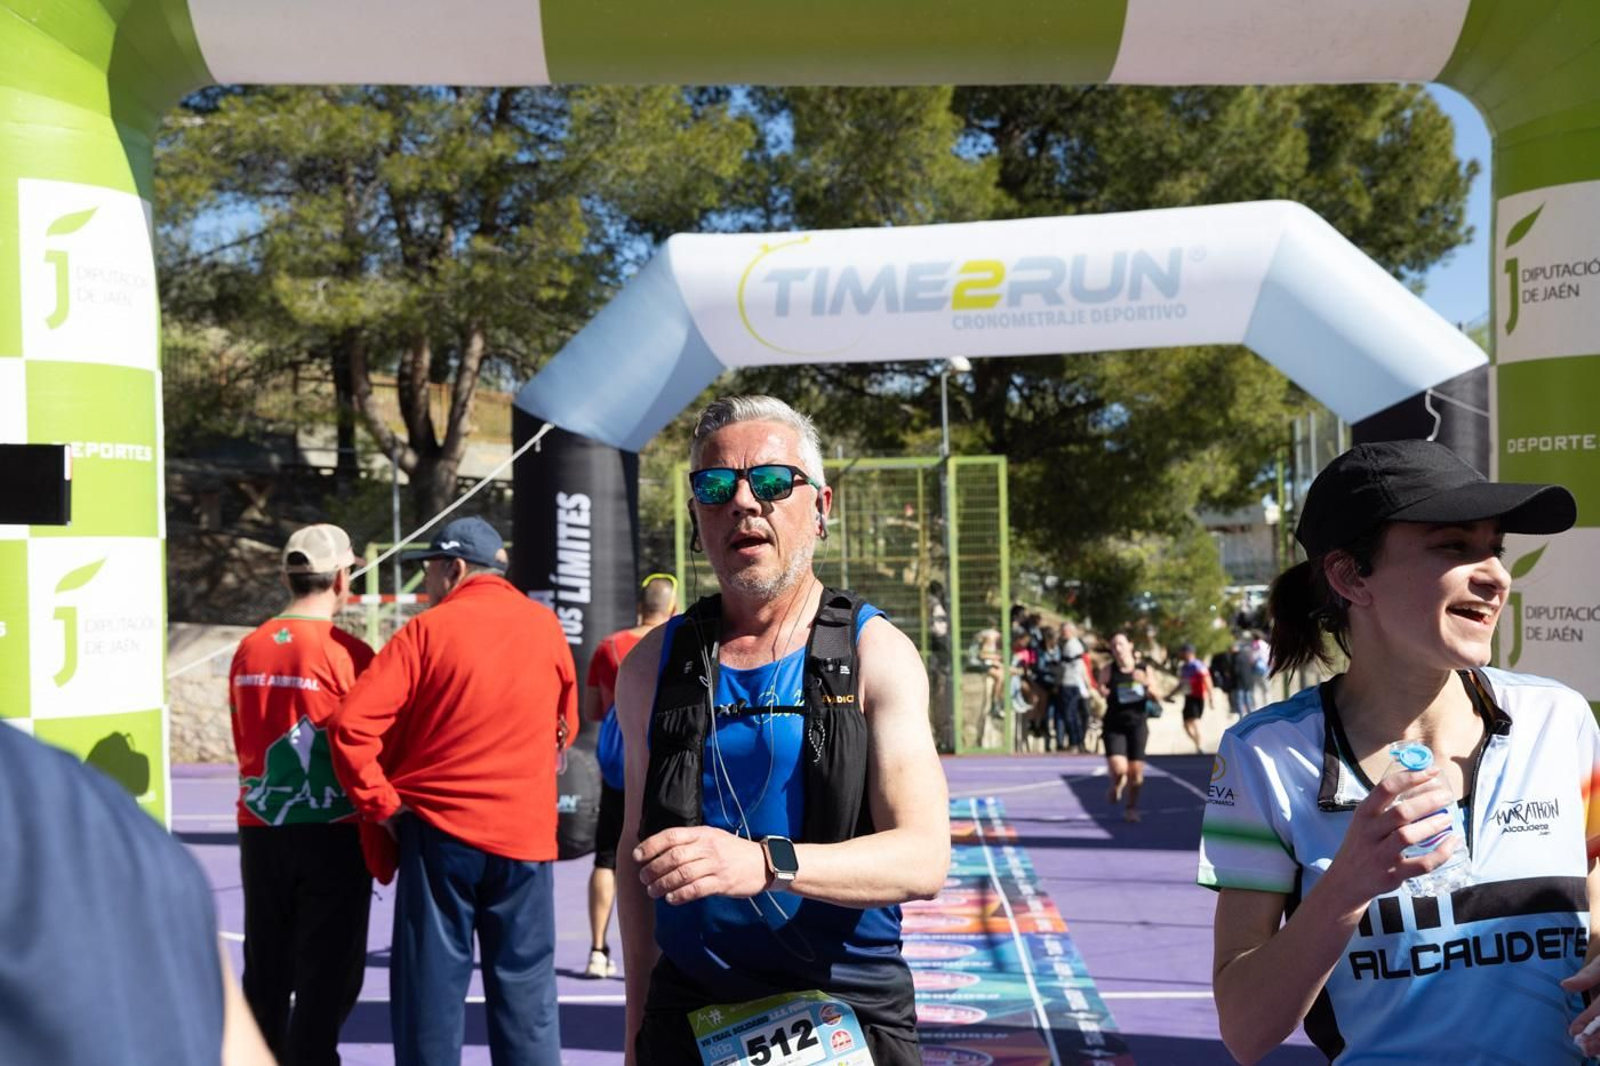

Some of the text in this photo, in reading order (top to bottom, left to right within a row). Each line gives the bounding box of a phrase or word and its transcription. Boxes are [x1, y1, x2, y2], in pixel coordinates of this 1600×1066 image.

[761, 247, 1183, 317] TIME2RUN
[1522, 282, 1580, 304] DE JAÉN
[951, 303, 1188, 331] CRONOMETRAJE DEPORTIVO
[66, 441, 152, 461] EPORTES
[1507, 434, 1600, 453] DEPORTE
[549, 491, 592, 604] LÍMITES
[1525, 626, 1583, 642] DE JAÉN
[1207, 786, 1234, 801] EVA
[1489, 797, 1560, 826] MARATHON
[1348, 927, 1588, 981] ALCAUDETE
[746, 1018, 819, 1066] 512
